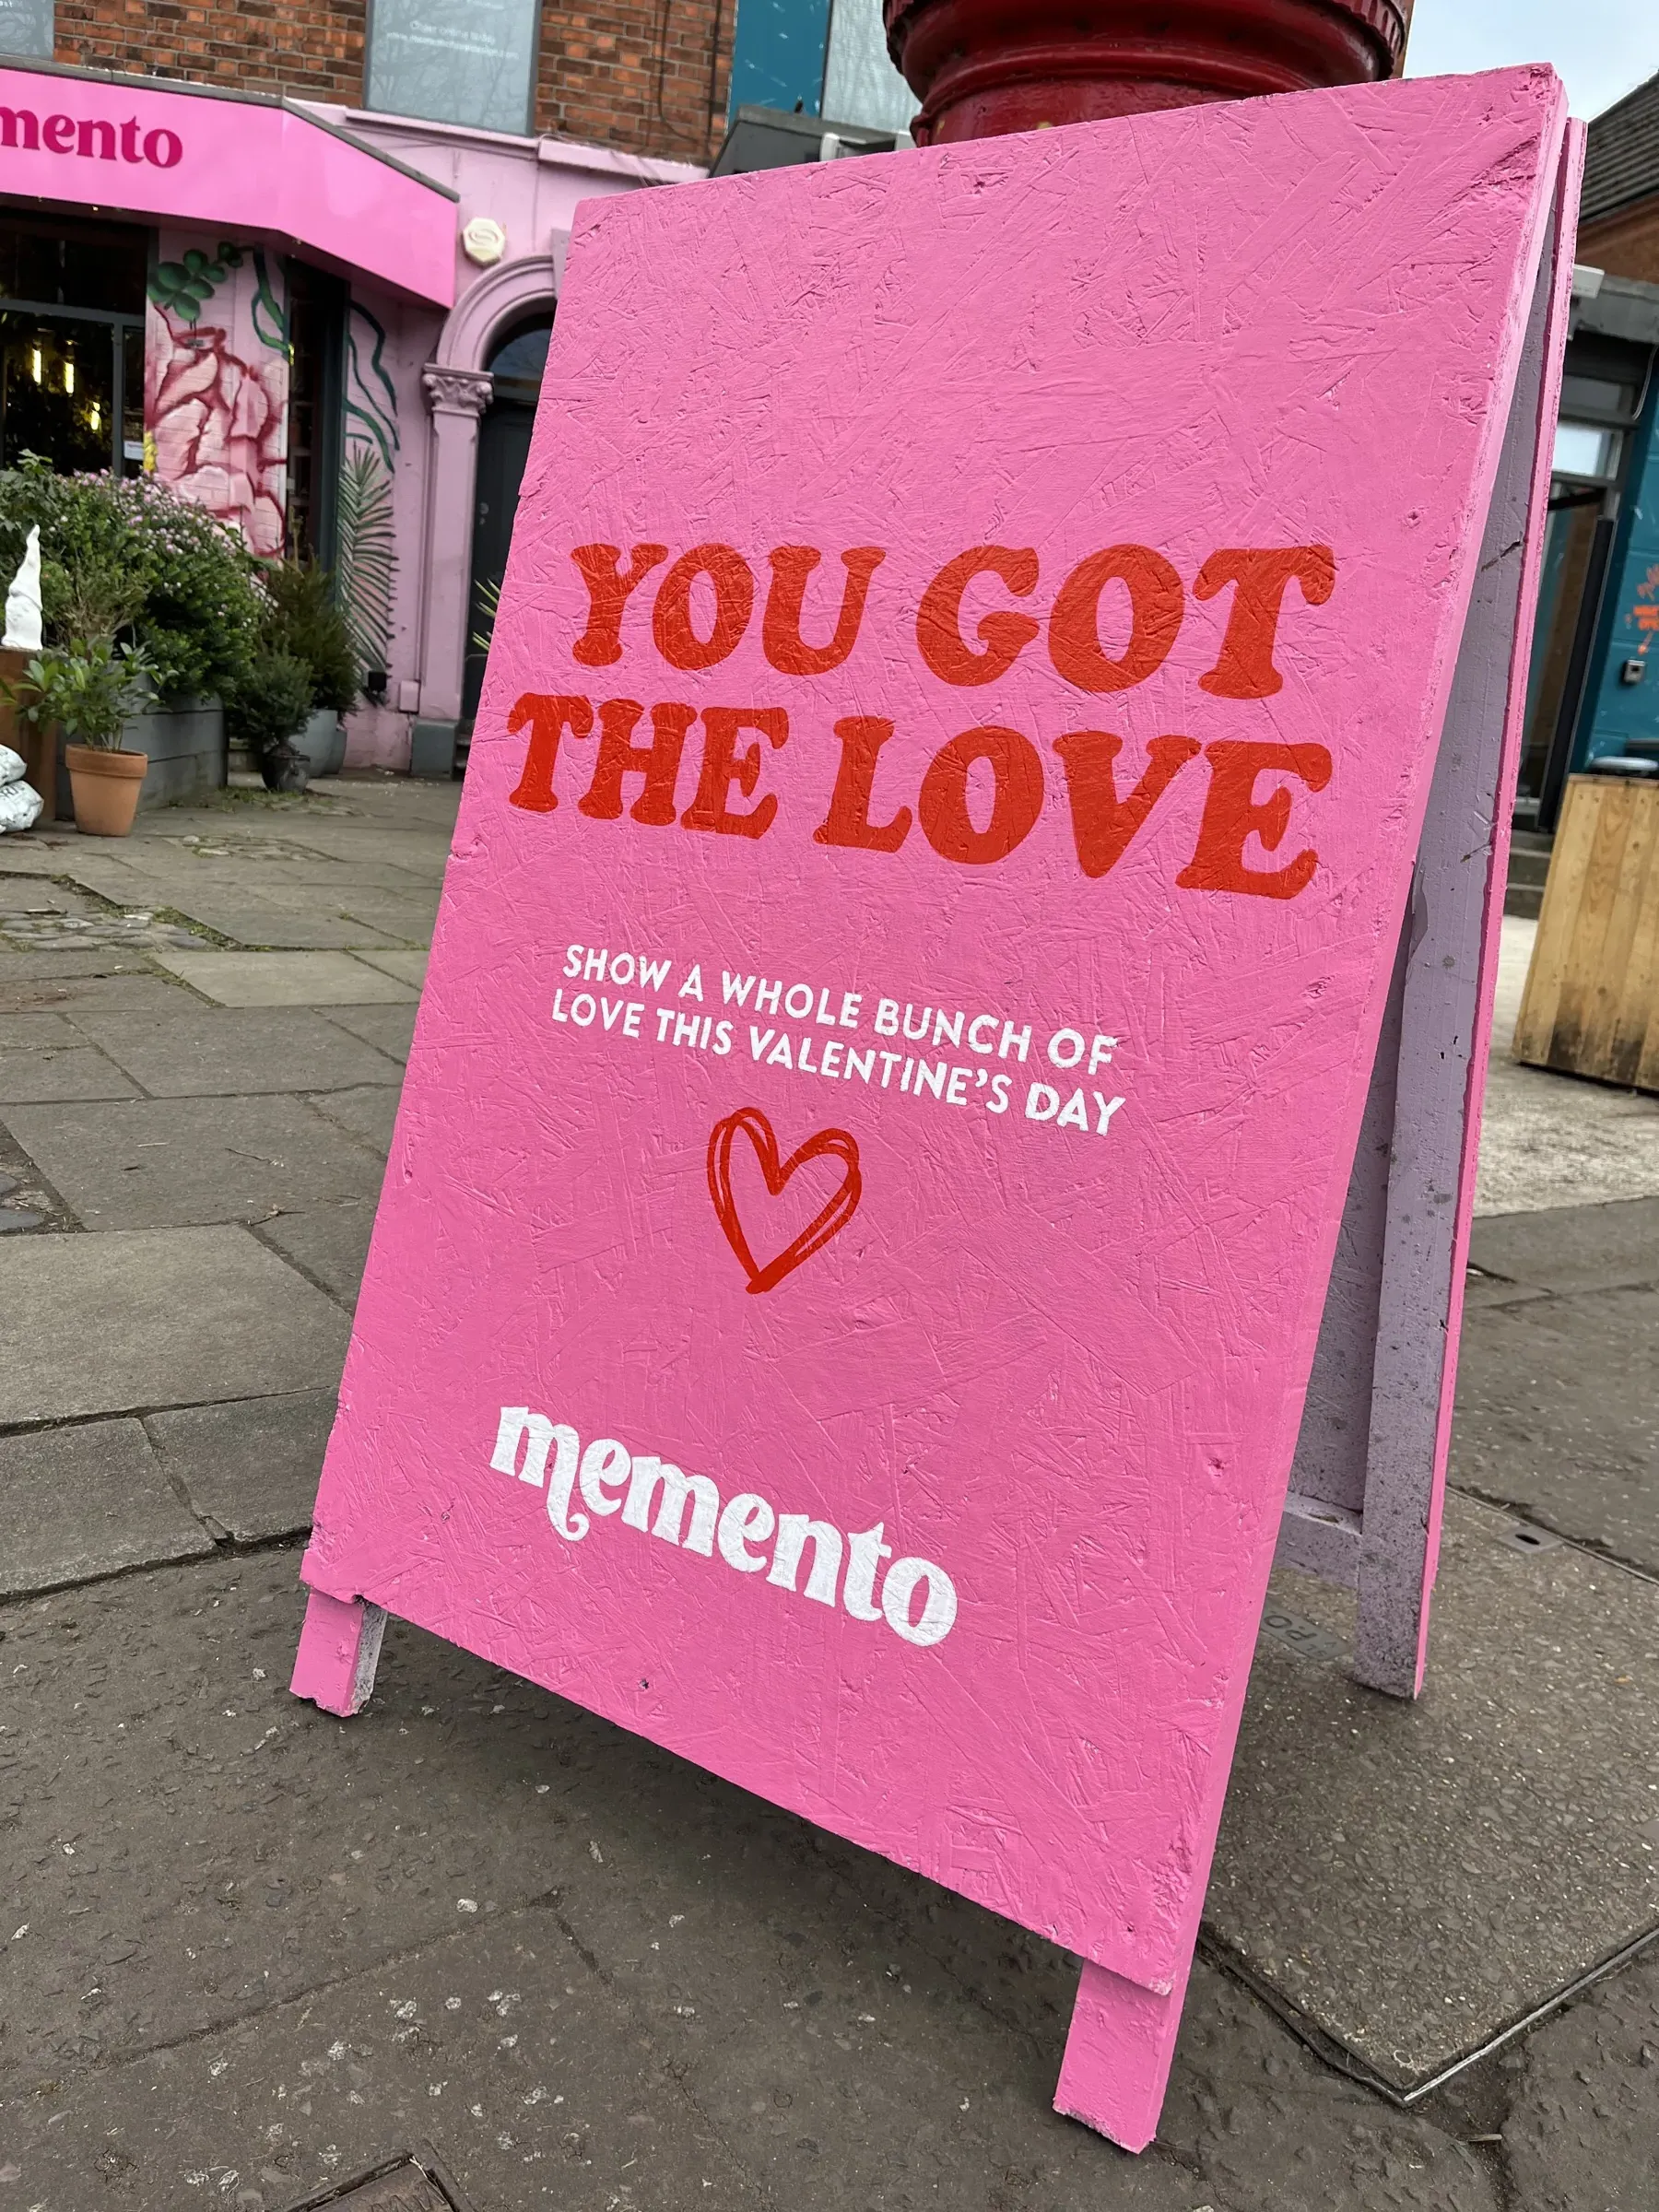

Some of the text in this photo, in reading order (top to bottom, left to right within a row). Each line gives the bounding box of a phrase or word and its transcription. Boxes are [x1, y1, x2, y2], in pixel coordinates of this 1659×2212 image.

[571, 543, 1335, 700] YOU GOT
[507, 692, 1334, 900] THE LOVE
[551, 988, 1127, 1136] LOVE THIS VALENTINE'S DAY
[563, 944, 1119, 1076] SHOW A WHOLE BUNCH OF
[489, 1406, 959, 1647] memento
